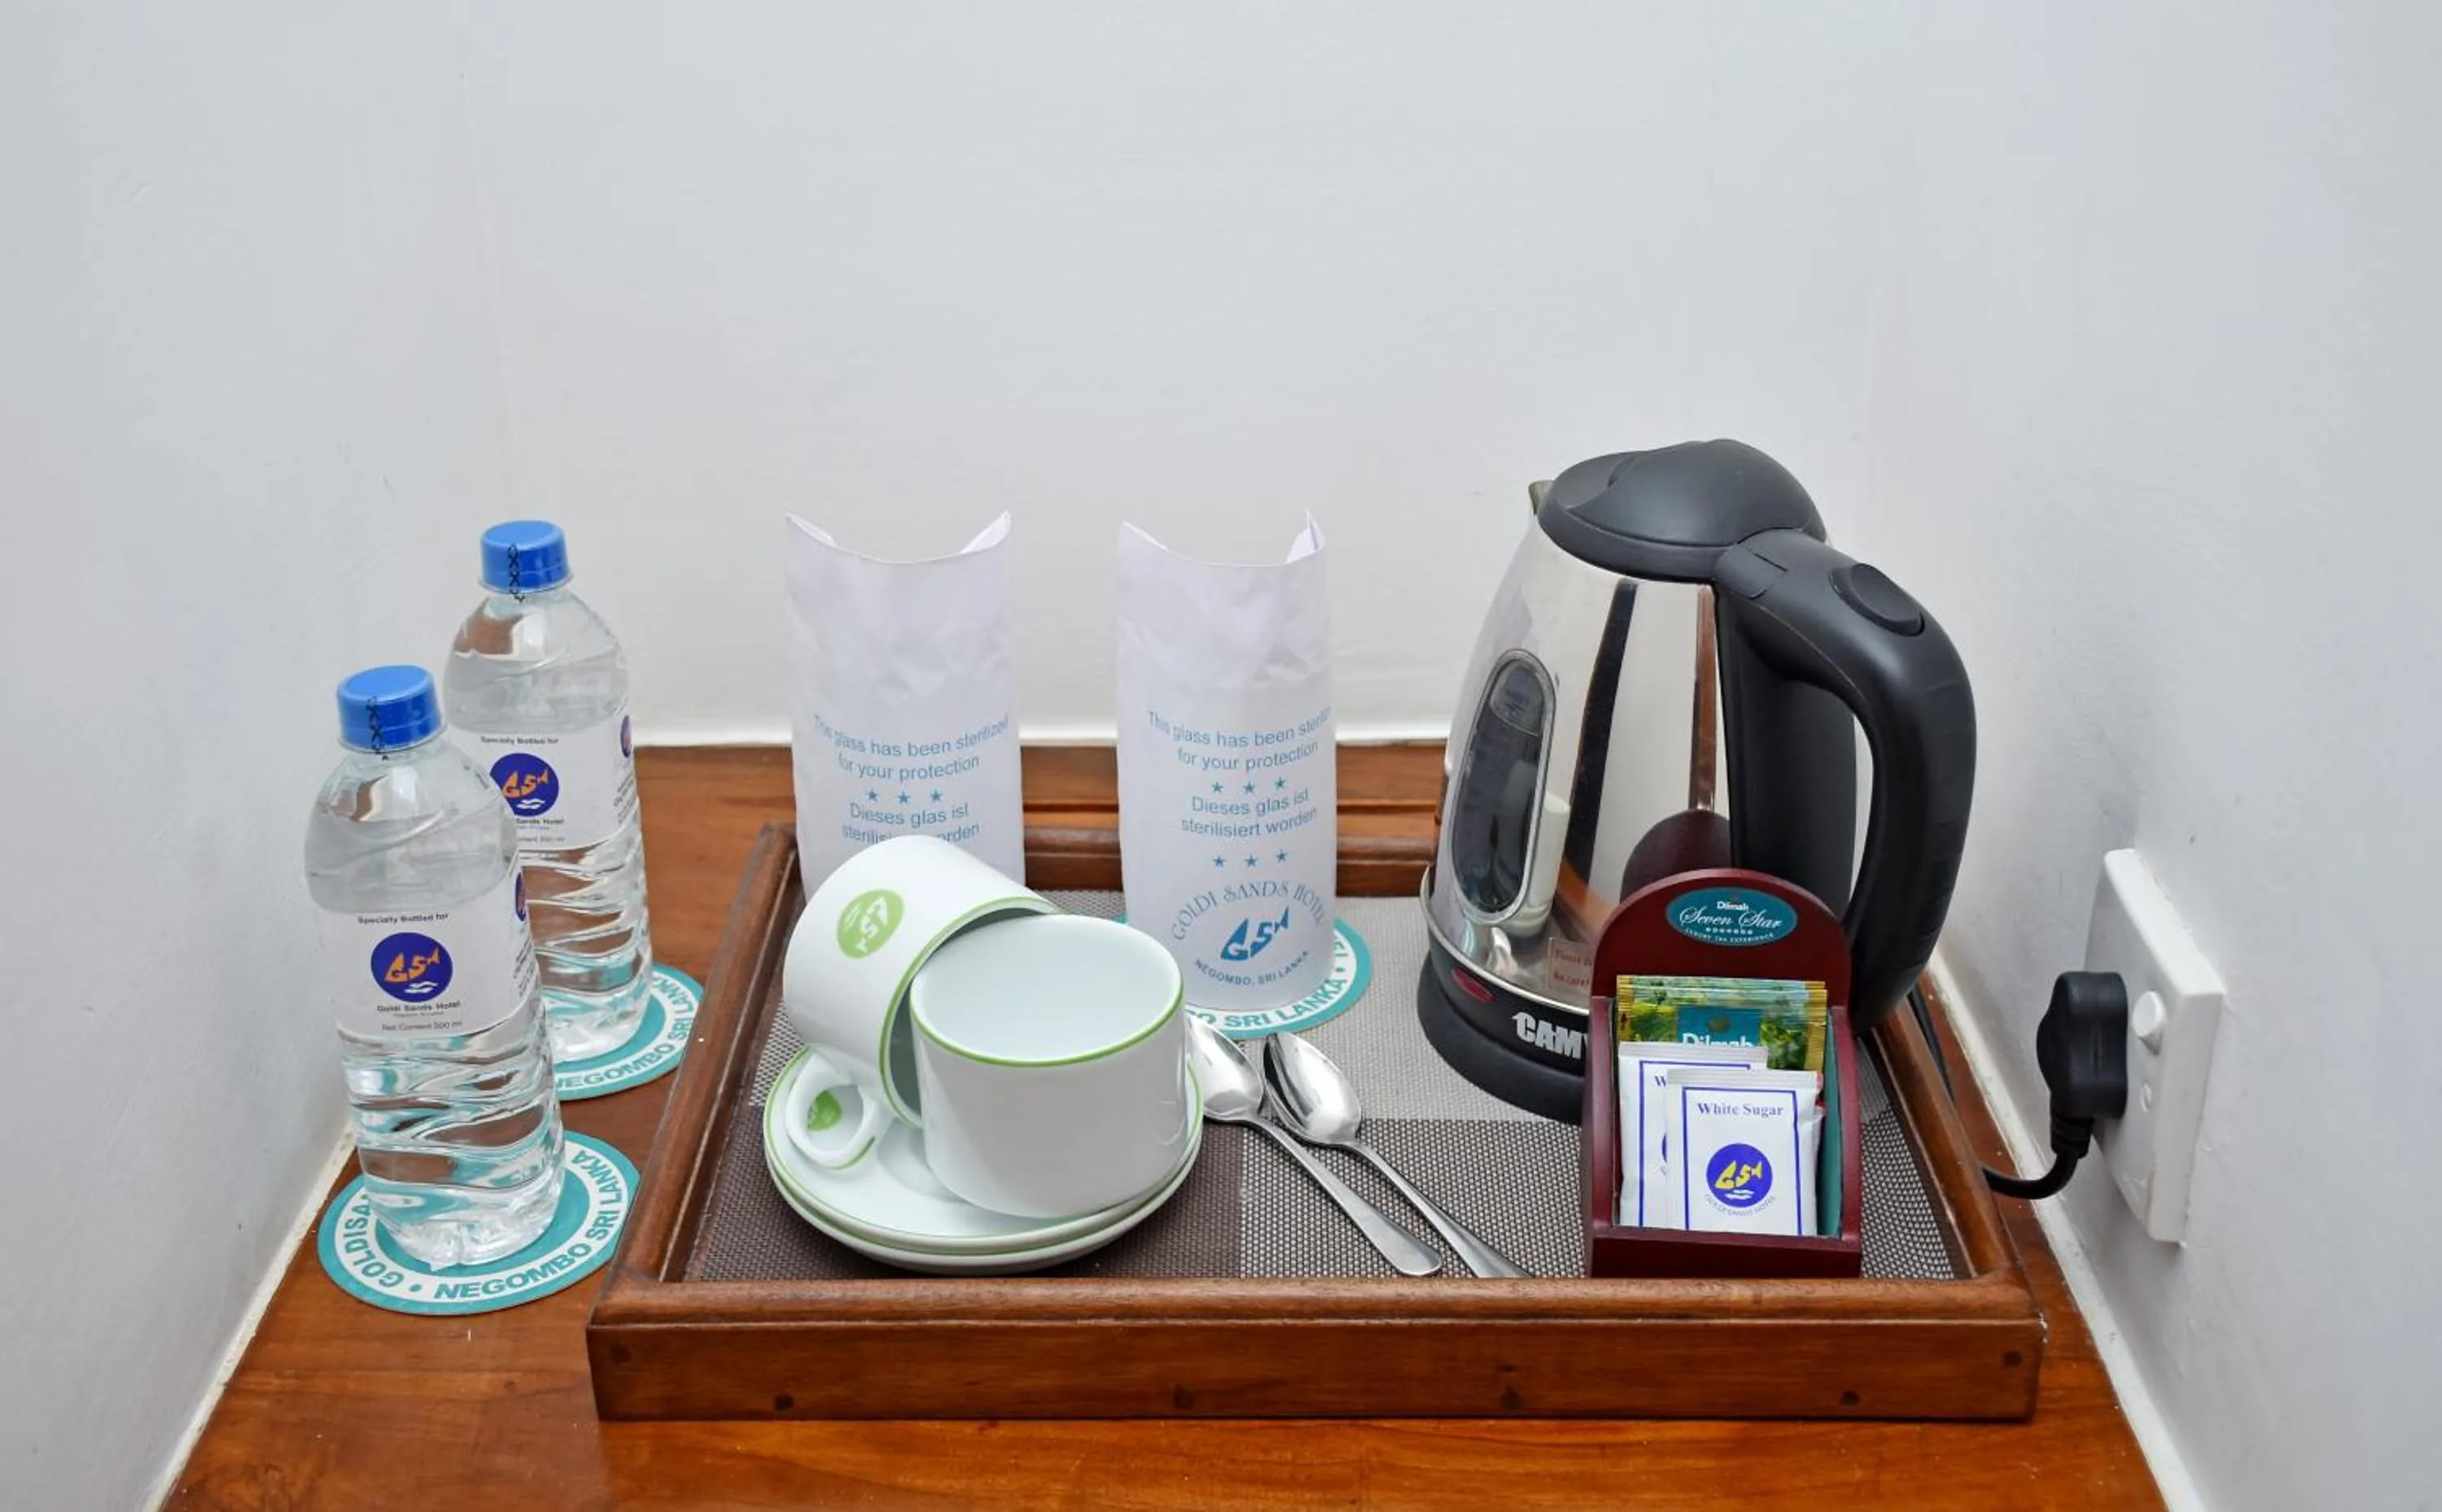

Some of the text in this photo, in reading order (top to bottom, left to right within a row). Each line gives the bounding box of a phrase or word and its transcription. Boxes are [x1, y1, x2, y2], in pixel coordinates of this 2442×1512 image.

[1173, 725, 1210, 745] glass
[1217, 732, 1248, 747] has
[1254, 727, 1294, 745] been
[871, 741, 901, 757] has
[908, 740, 951, 757] been
[1178, 741, 1318, 772] for your protection
[838, 752, 979, 783] for your protection
[849, 803, 905, 825] Dieses
[910, 809, 947, 828] glas
[1192, 796, 1250, 815] Dieses
[1256, 796, 1289, 817] glas
[842, 824, 979, 844] sterilis orden
[1181, 807, 1317, 837] sterilisiert worden
[1172, 891, 1218, 940] GOLDI
[1223, 881, 1289, 902] SANDS
[1679, 906, 1783, 929] Seven Star
[1224, 1014, 1271, 1028] SRI
[1276, 978, 1347, 1020] LANKA
[667, 1017, 694, 1040] SRI
[1697, 1103, 1784, 1118] White Sugar
[434, 1150, 622, 1300] NEGOMBO SRI LANKA
